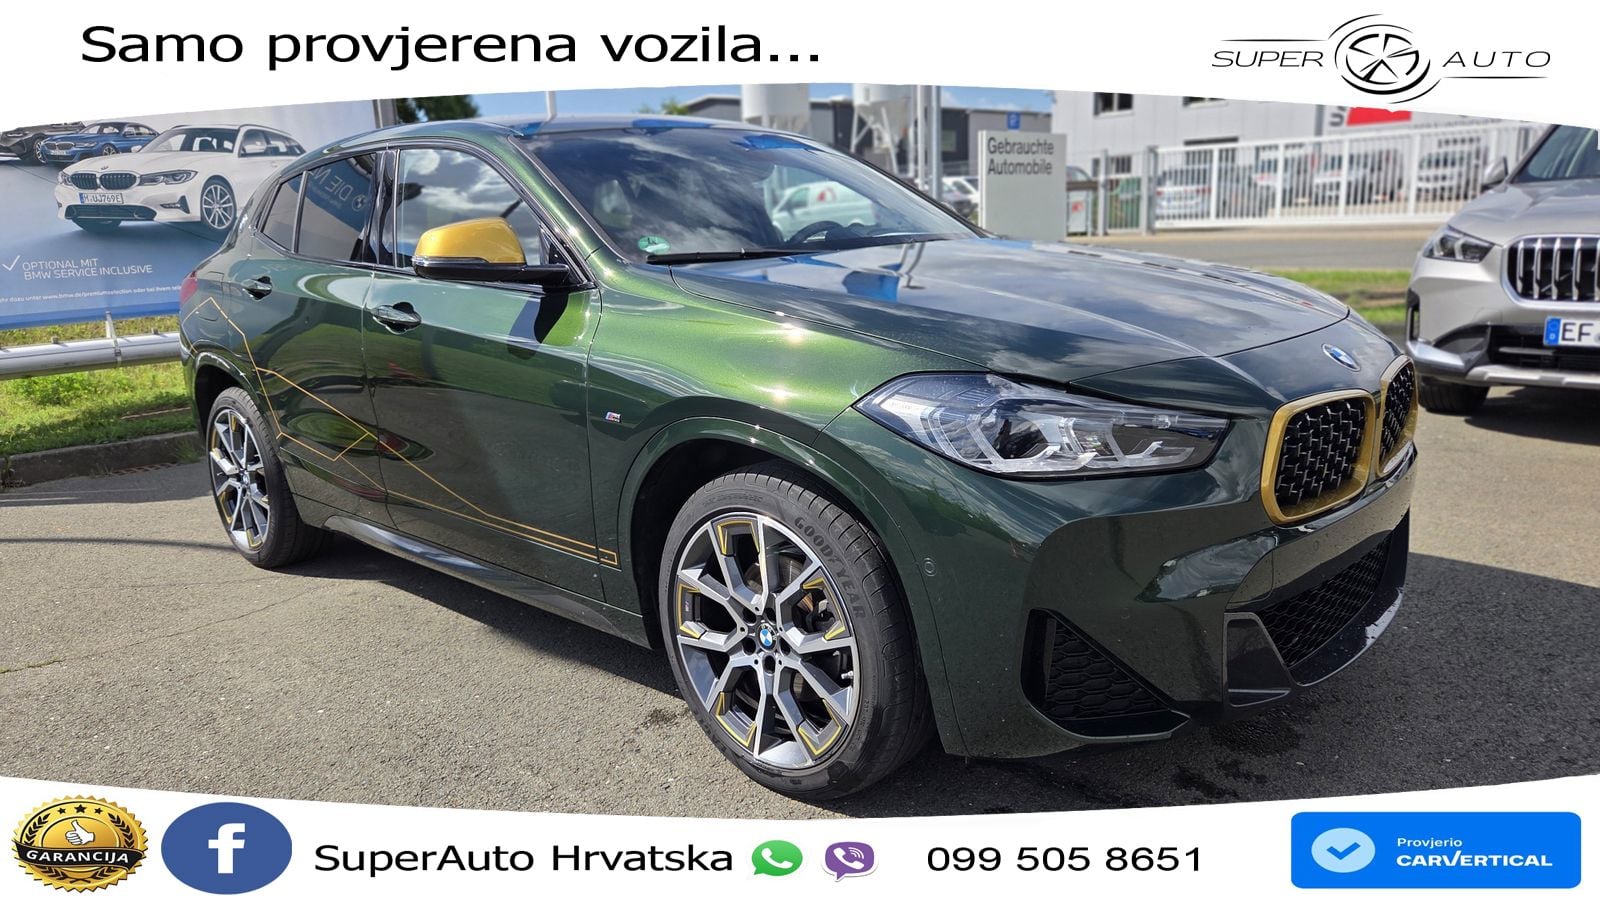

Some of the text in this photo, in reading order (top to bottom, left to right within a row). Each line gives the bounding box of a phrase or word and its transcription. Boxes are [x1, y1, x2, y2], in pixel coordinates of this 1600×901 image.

[987, 136, 1055, 155] Gebrauchte
[987, 158, 1053, 176] Automobile
[22, 258, 98, 272] OPTIONAL MIT
[24, 264, 153, 281] BMW SERVICE INCLUSIVE
[1561, 322, 1594, 342] EF
[794, 516, 866, 619] GOODYEAR
